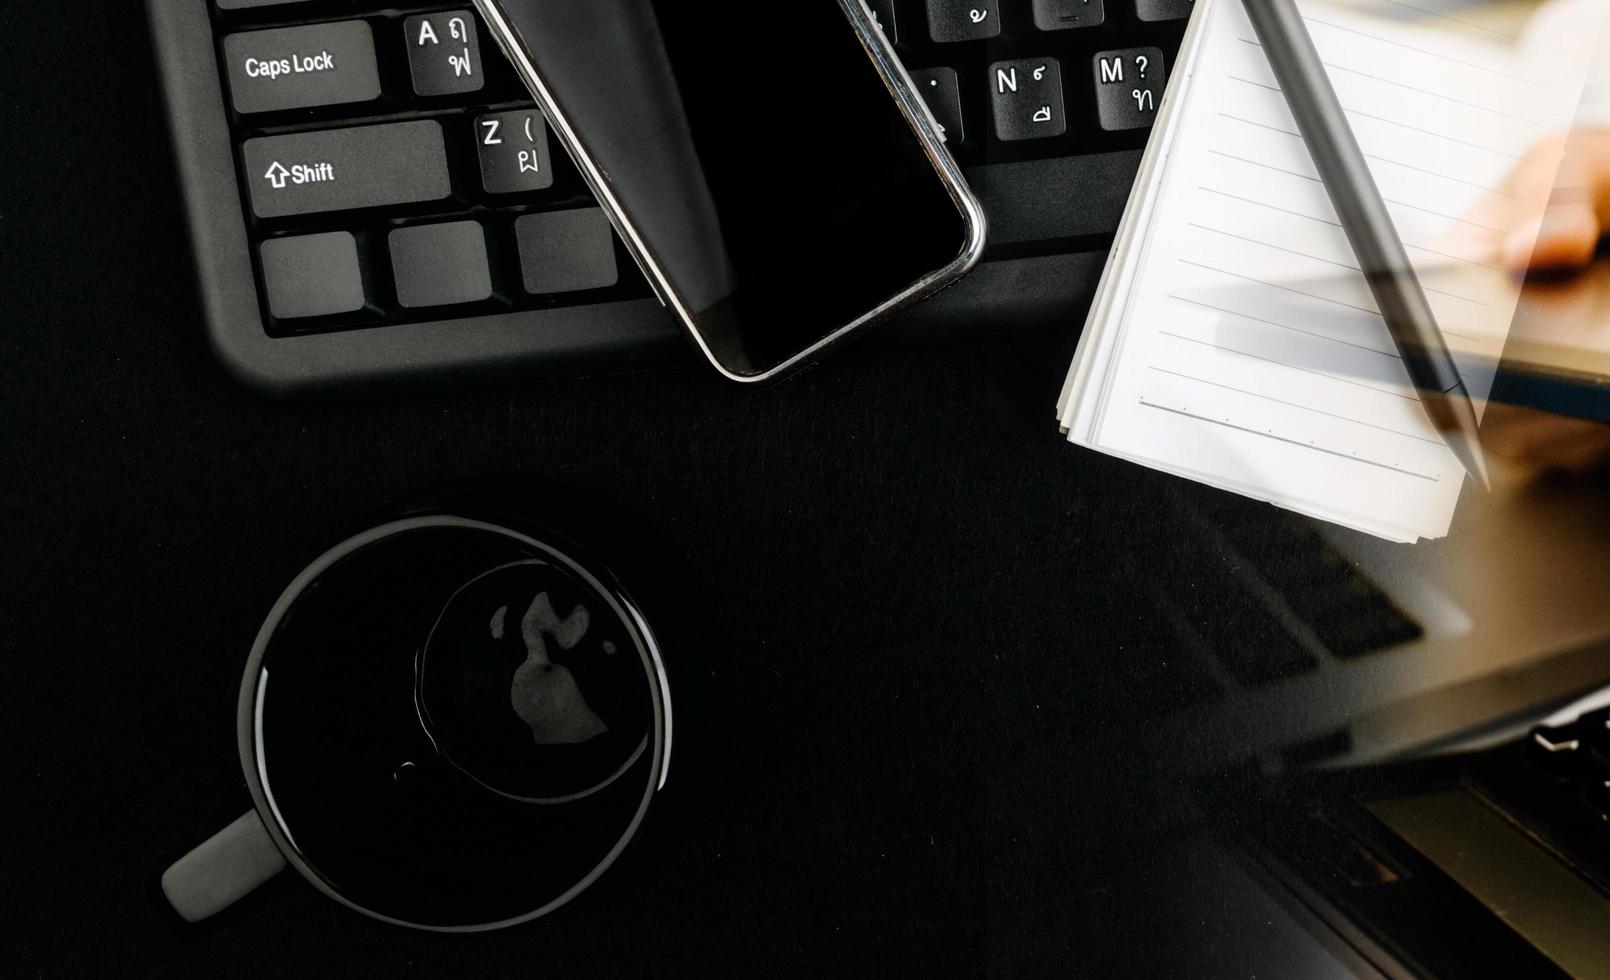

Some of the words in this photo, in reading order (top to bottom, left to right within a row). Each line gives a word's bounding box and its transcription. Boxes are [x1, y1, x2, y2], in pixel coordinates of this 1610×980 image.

[418, 20, 439, 46] A
[245, 58, 291, 80] Caps
[292, 51, 334, 73] Lock
[1100, 57, 1123, 83] M
[1135, 55, 1148, 79] ?
[997, 68, 1017, 93] N
[482, 120, 502, 145] Z
[291, 162, 335, 184] Shift
